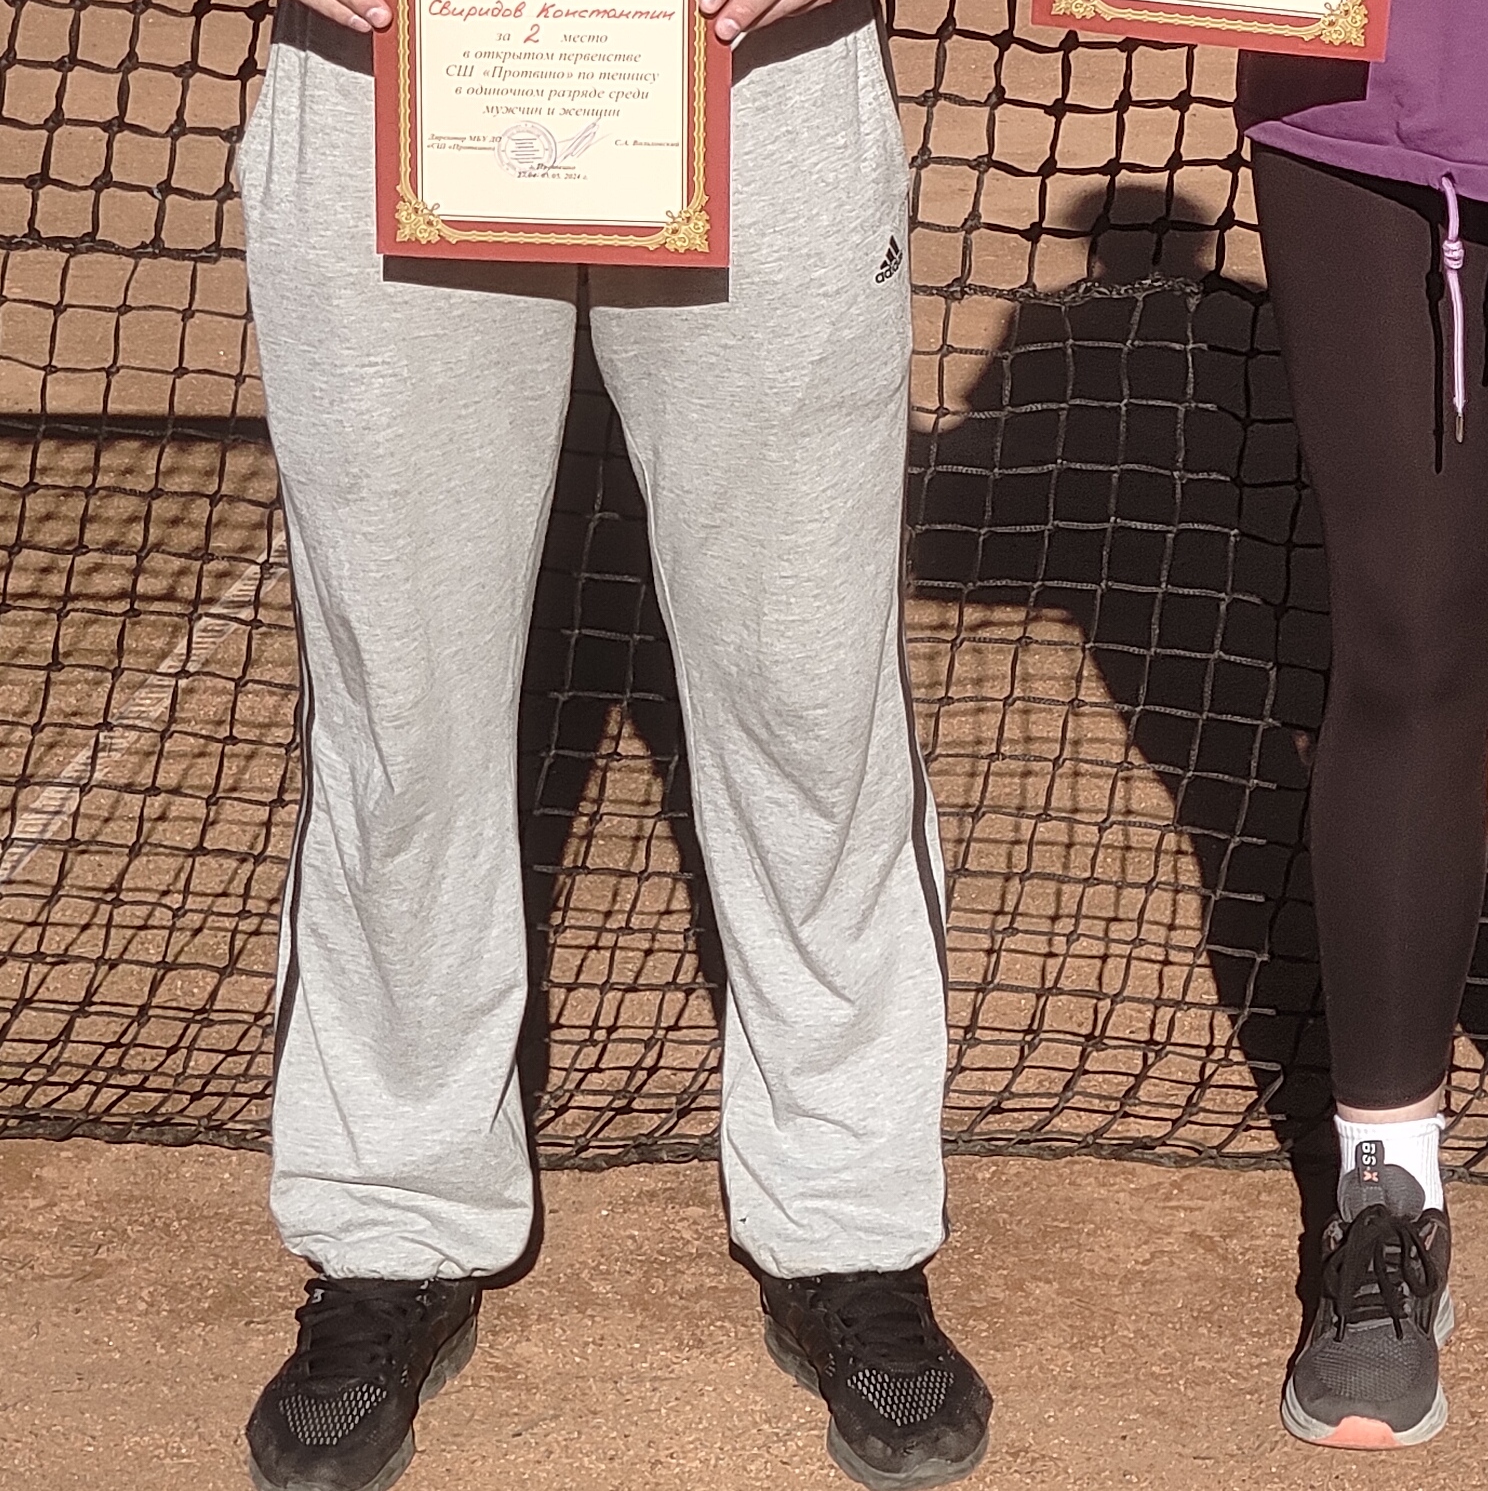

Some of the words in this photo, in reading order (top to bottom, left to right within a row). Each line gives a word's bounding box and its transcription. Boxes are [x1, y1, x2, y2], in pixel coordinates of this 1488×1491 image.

[536, 2, 676, 21] Константин
[495, 32, 511, 43] за
[523, 23, 541, 44] 2
[560, 32, 609, 44] место
[474, 49, 554, 65] открытом
[558, 51, 642, 65] первенстве
[445, 64, 474, 78] СШ
[482, 65, 574, 82] «Протвино»
[578, 70, 595, 81] по
[599, 70, 660, 85] теннису
[466, 84, 544, 98] одиночном
[547, 86, 605, 102] разряде
[608, 88, 650, 102] среди
[482, 105, 543, 118] мужчин
[547, 107, 555, 117] и
[559, 107, 621, 119] женщин
